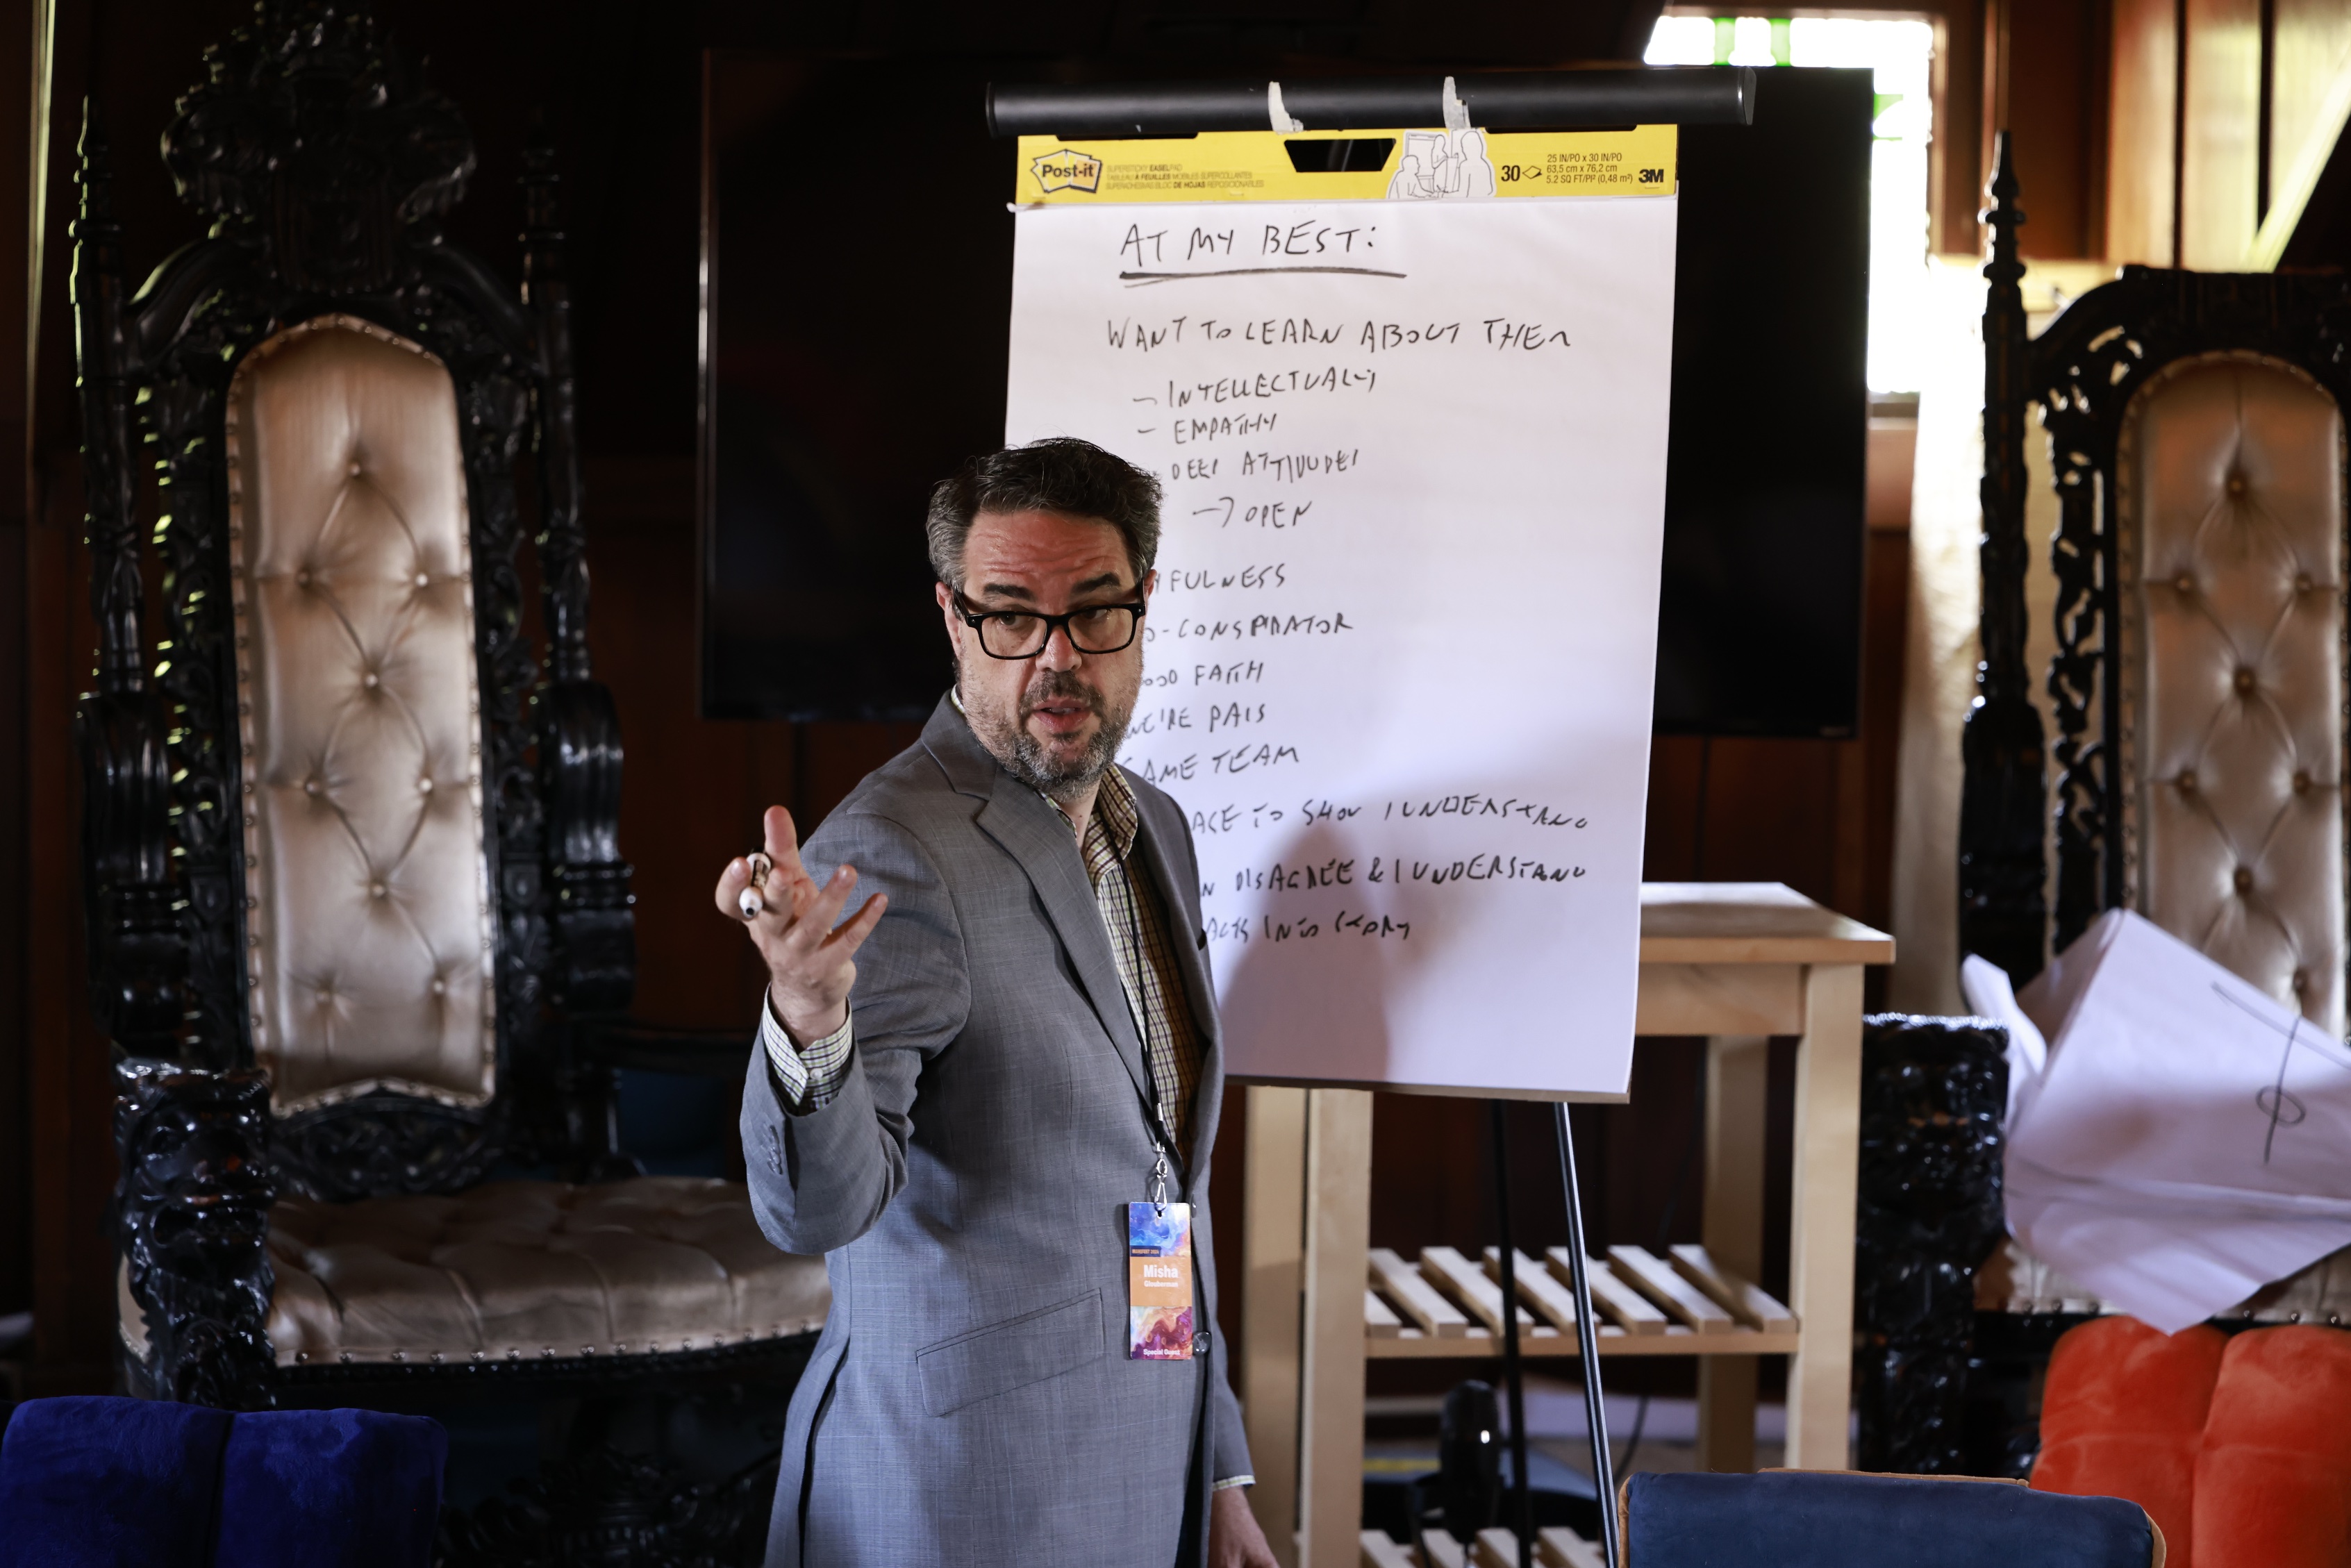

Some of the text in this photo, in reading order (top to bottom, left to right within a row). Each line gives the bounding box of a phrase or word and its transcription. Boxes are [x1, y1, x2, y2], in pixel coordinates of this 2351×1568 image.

[1547, 154, 1557, 162] 25
[1559, 153, 1580, 162] IN/PO
[1589, 153, 1600, 162] 30
[1601, 152, 1622, 162] IN/PO
[1042, 162, 1094, 178] Post-it
[1501, 165, 1520, 181] 30
[1547, 165, 1563, 174] 63,5
[1586, 164, 1603, 173] 76,2
[1638, 169, 1664, 183] 3M
[1546, 174, 1558, 183] 5.2
[1560, 174, 1571, 183] SQ
[1597, 173, 1618, 183] (0,48
[1119, 219, 1377, 268] AT MY BEST:
[1107, 315, 1188, 353] WANT
[1199, 319, 1233, 341] TO
[1245, 317, 1345, 346] LEARN
[1359, 319, 1461, 354] ABOUT
[1244, 500, 1313, 530] OPEN
[1144, 669, 1178, 687] OOD
[1124, 742, 1300, 786] AME TEAM
[1193, 803, 1243, 835] ACE
[1368, 856, 1384, 883] &
[1144, 1265, 1179, 1278] Misha
